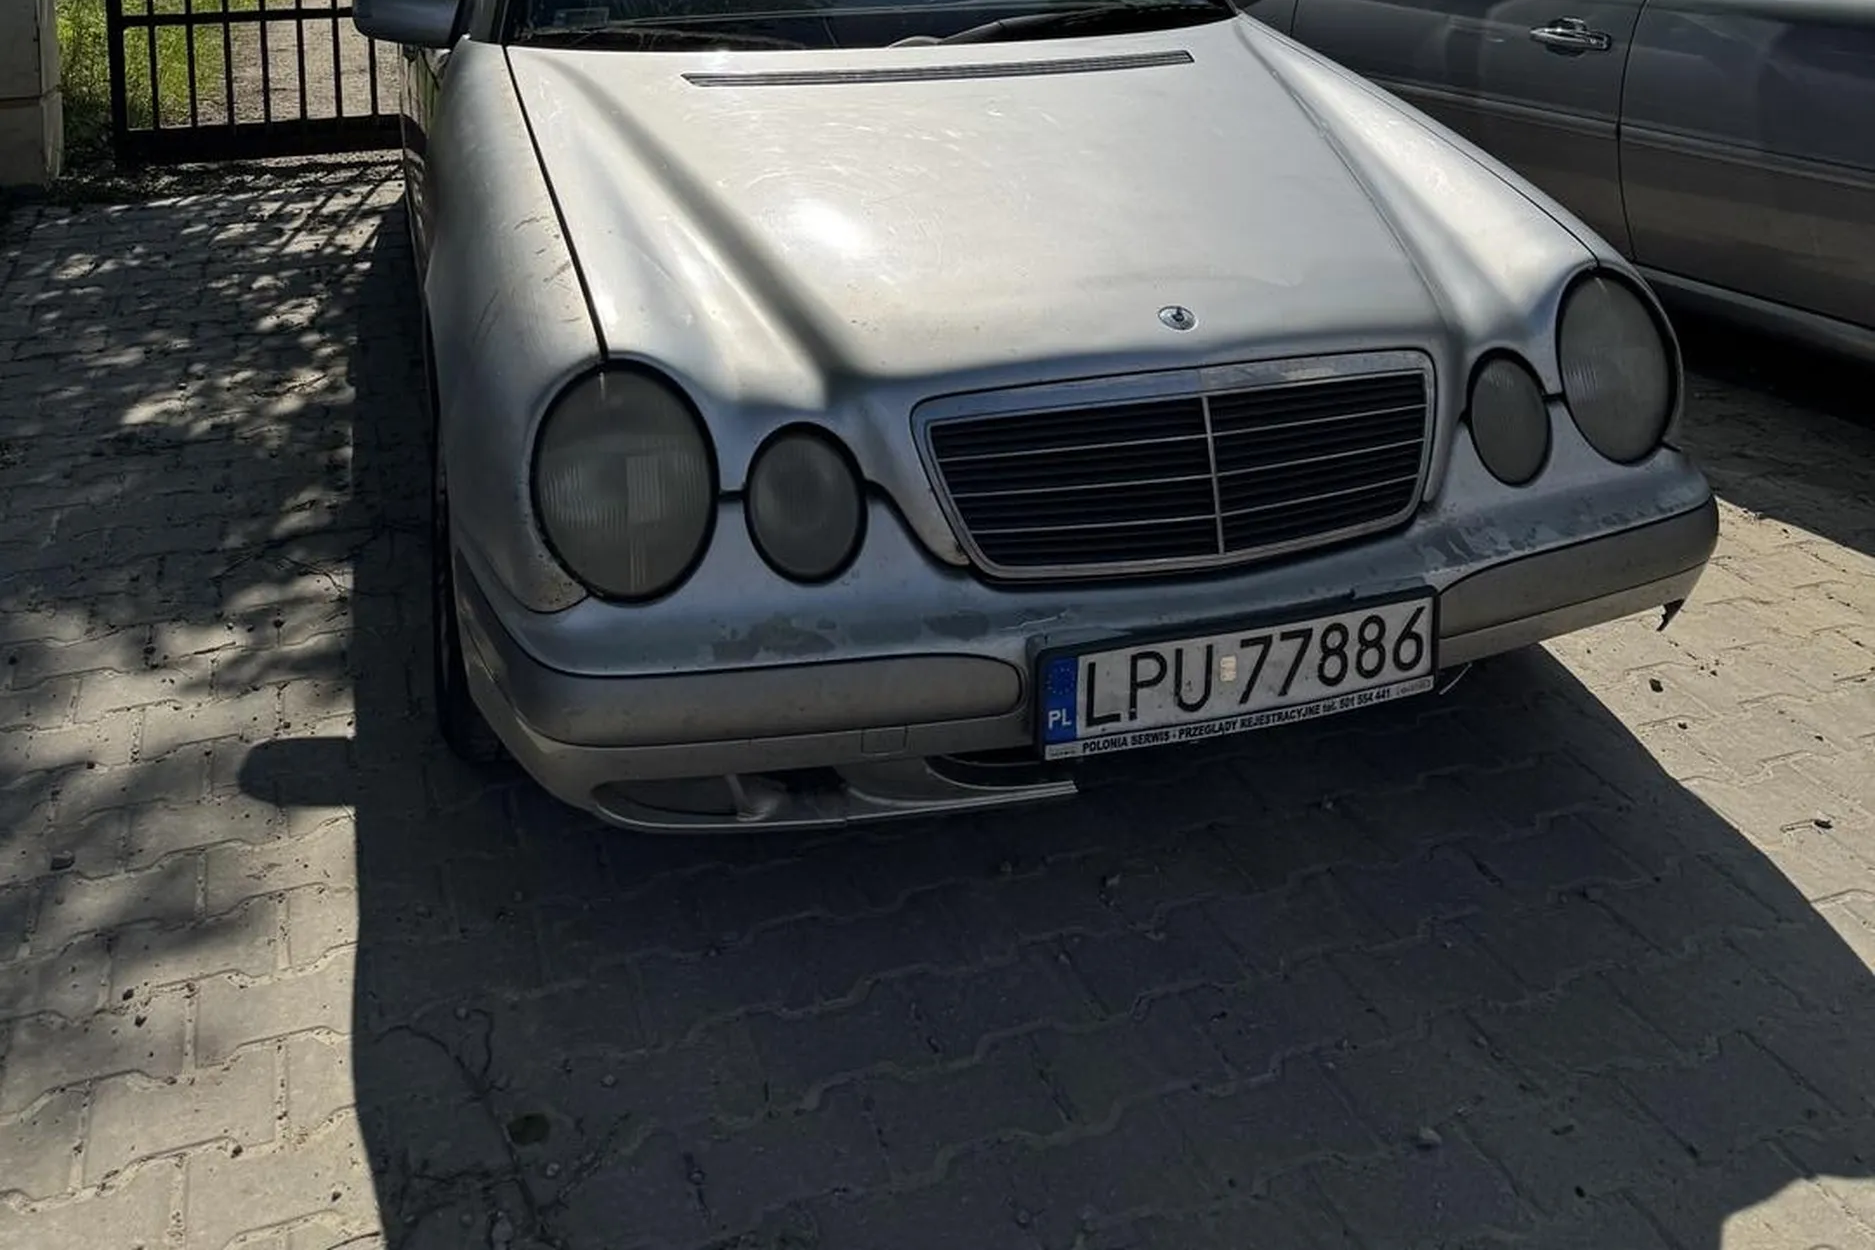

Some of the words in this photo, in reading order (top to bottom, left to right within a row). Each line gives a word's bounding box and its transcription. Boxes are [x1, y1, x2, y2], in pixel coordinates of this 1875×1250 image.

[1085, 644, 1214, 728] LPU
[1238, 606, 1426, 706] 77886
[1047, 709, 1073, 730] PL
[1082, 736, 1129, 754] POLONIA
[1131, 731, 1170, 747] SERWIS
